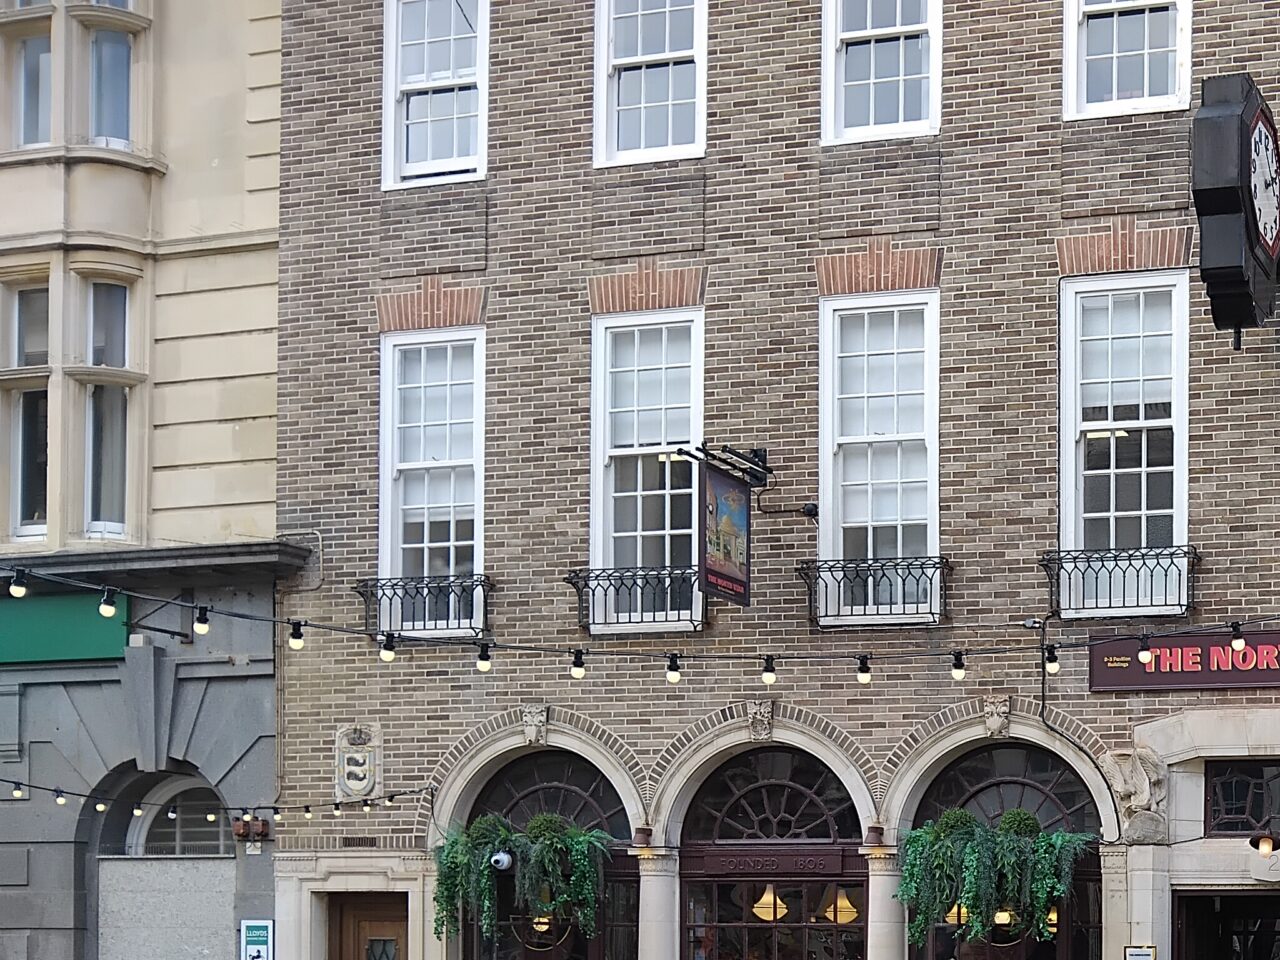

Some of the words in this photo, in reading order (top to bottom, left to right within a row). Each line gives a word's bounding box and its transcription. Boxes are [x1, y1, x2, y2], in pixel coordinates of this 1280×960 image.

[1144, 647, 1201, 673] THE
[720, 857, 779, 870] FOUNDED
[1269, 854, 1280, 872] 2
